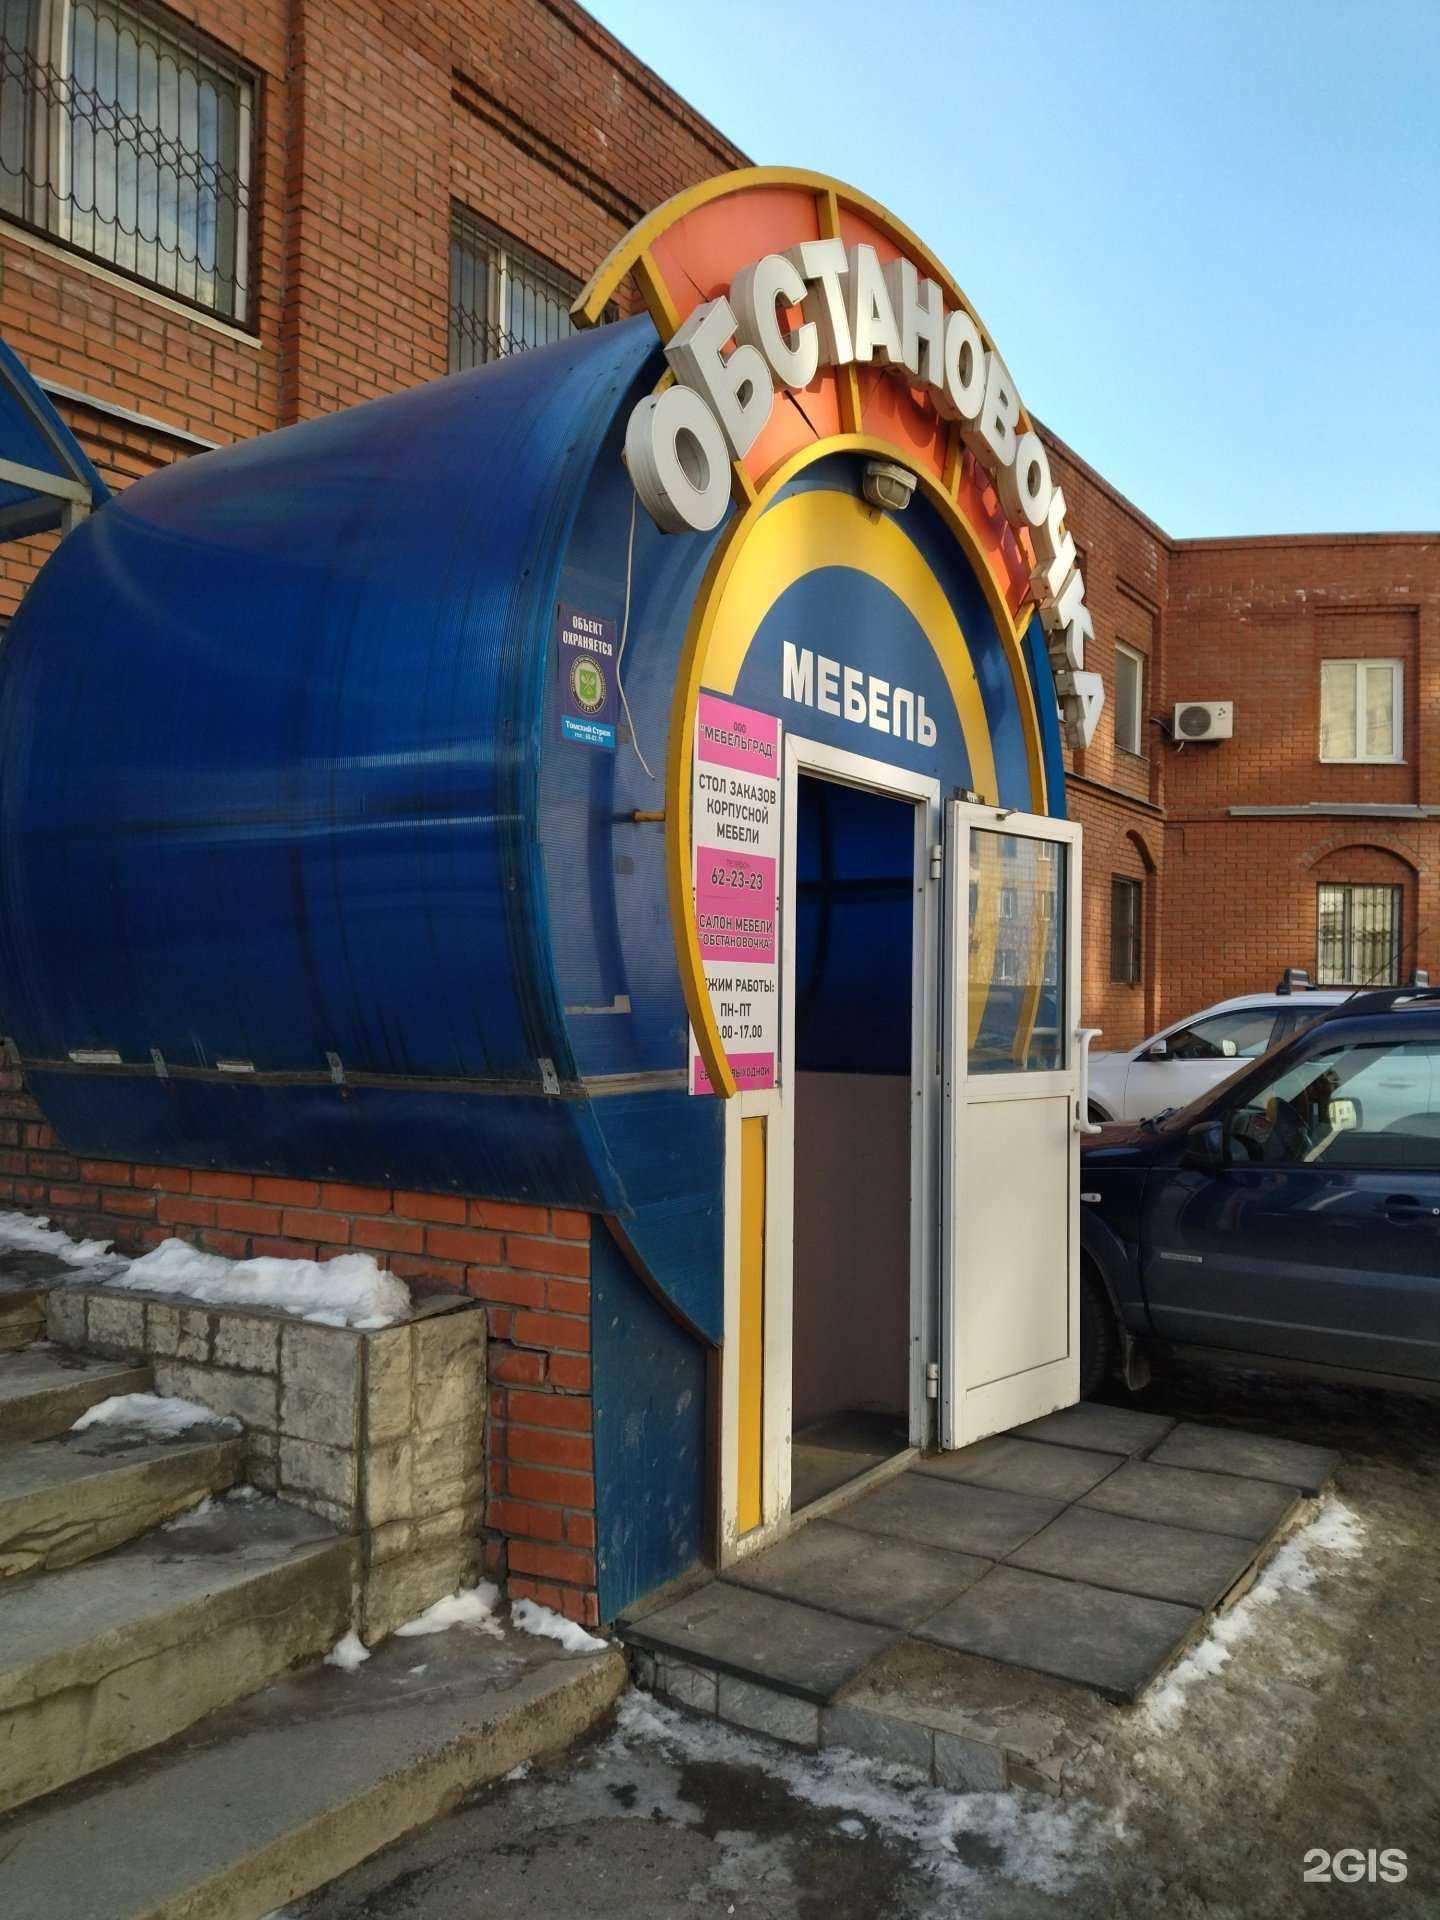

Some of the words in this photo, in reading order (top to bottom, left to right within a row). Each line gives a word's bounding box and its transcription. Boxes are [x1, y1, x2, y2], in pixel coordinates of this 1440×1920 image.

[572, 615, 603, 636] ОБЪЕКТ
[562, 630, 613, 657] ОХРАНЯЕТСЯ
[782, 640, 938, 748] МЕБЕЛЬ
[733, 721, 747, 734] ООО
[699, 773, 726, 794] СТОЛ
[730, 780, 776, 805] ЗАКАЗОВ
[707, 797, 769, 824] КОРПУСНОЙ
[717, 822, 760, 844] МЕБЕЛИ
[711, 867, 763, 891] 62-23-23
[699, 914, 732, 930] САЛОН
[736, 917, 773, 934] МЕБЕЛИ
[735, 978, 775, 993] РАБОТЫ:
[720, 1002, 752, 1017] ПН-ПТ
[716, 1024, 762, 1039] .00-17.00
